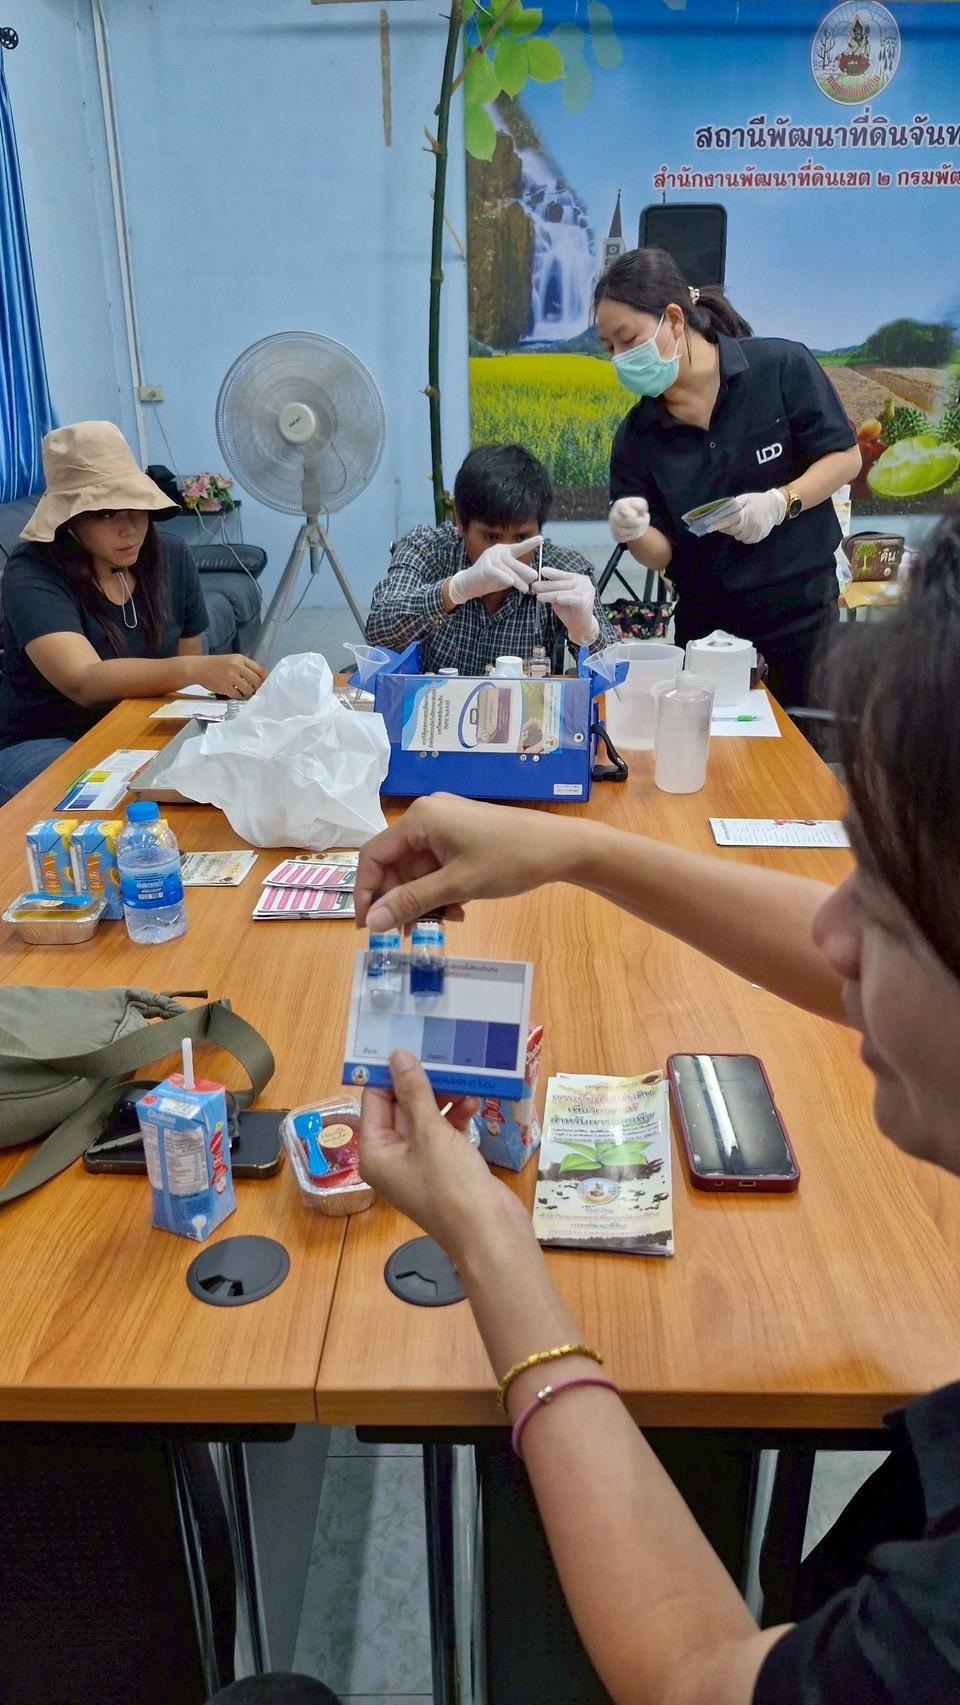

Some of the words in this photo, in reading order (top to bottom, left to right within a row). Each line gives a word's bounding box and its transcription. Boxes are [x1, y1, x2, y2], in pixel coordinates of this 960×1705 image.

[654, 159, 870, 188] สำนักงานพัฒนาที่ดินเขต
[756, 442, 783, 465] LDD
